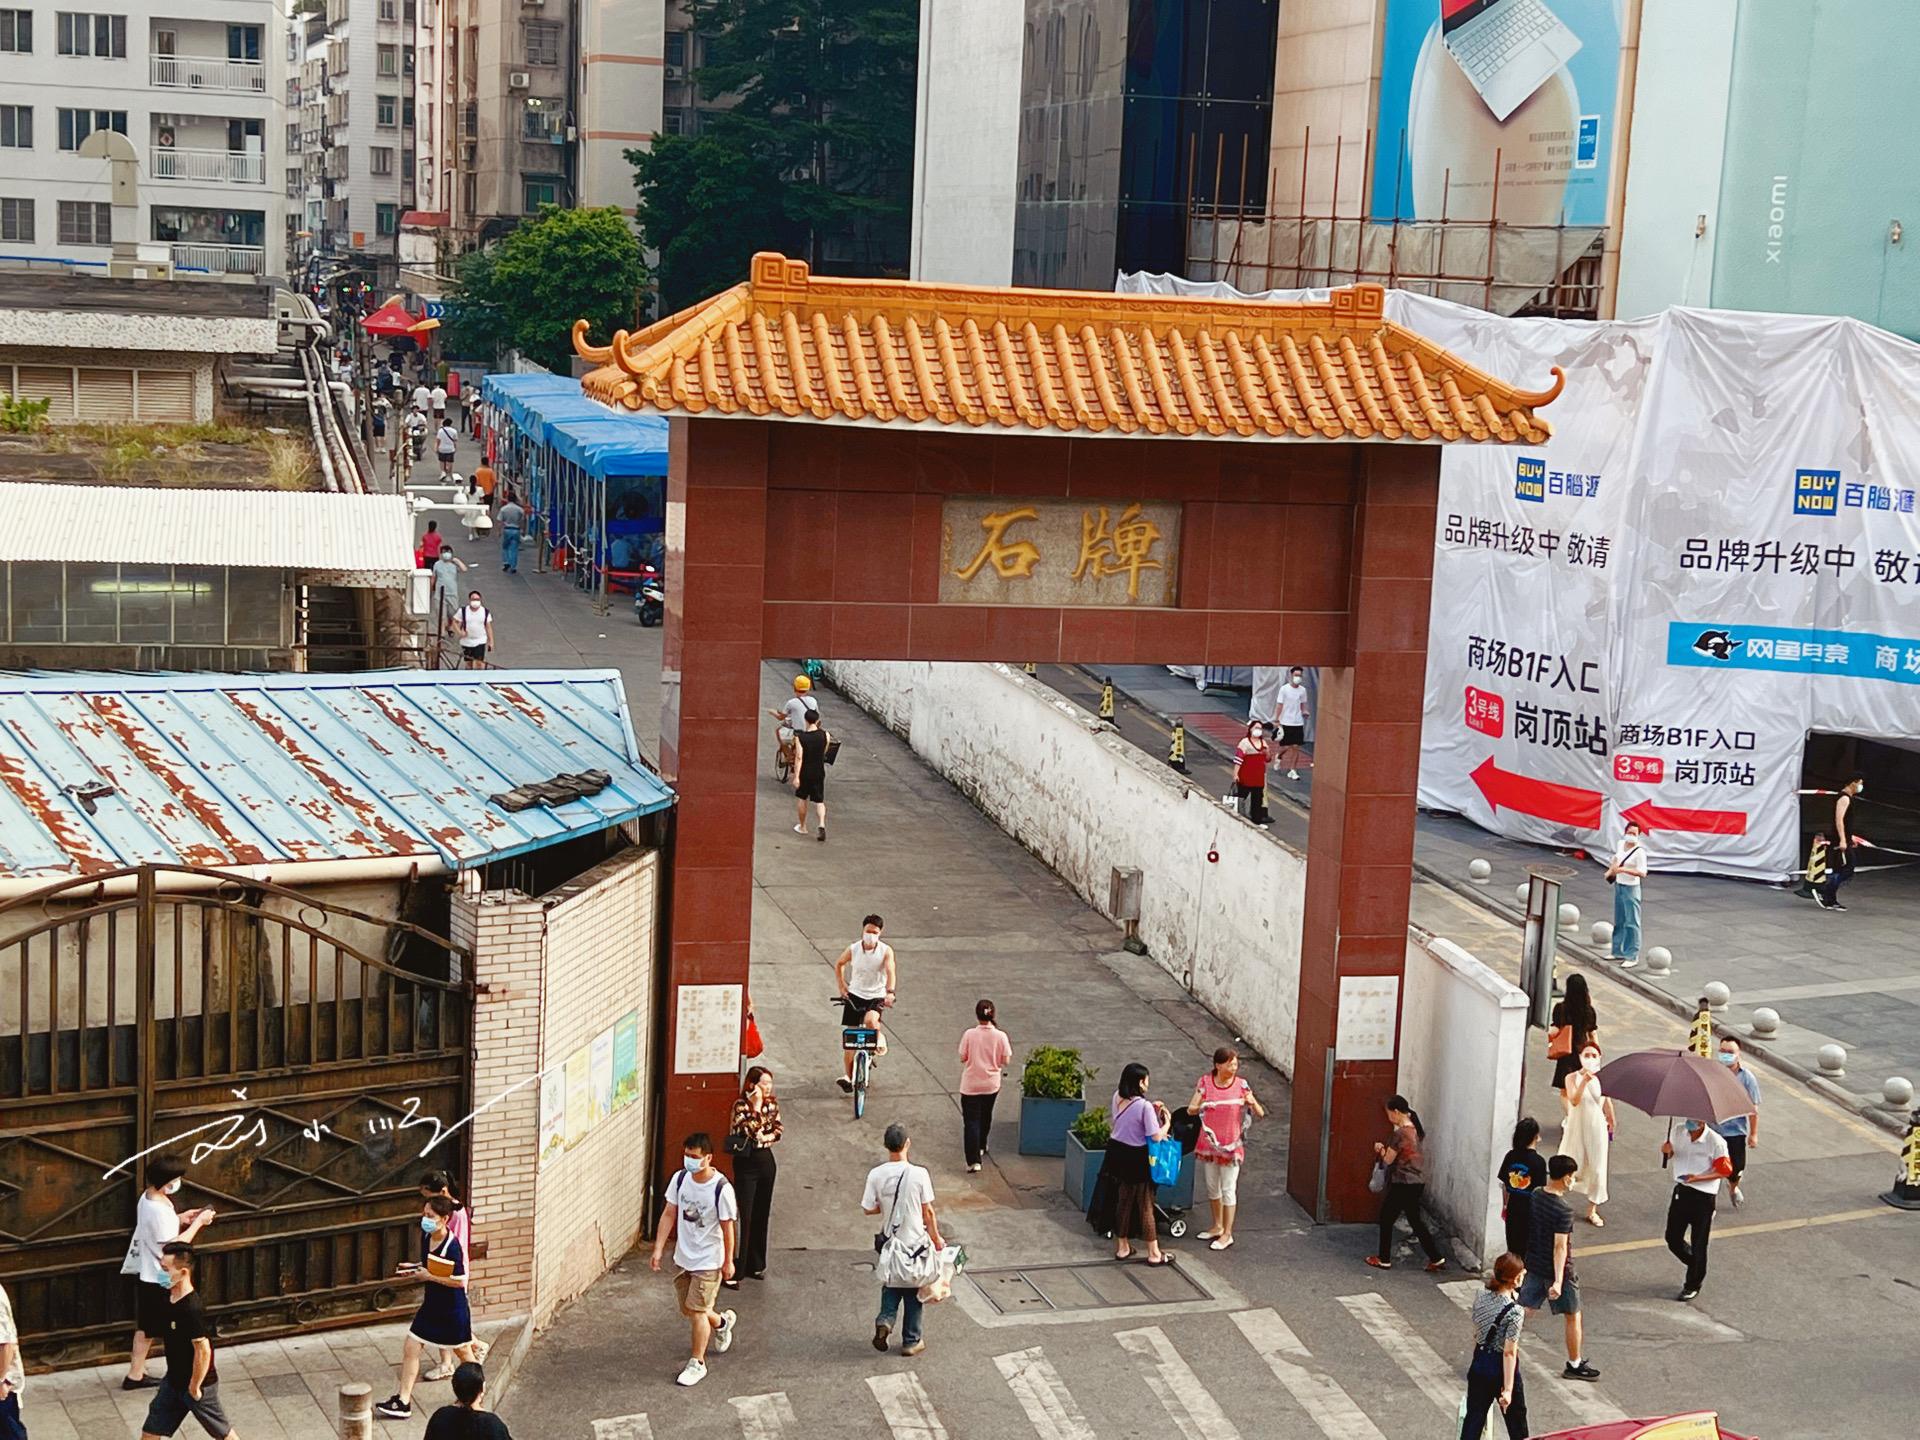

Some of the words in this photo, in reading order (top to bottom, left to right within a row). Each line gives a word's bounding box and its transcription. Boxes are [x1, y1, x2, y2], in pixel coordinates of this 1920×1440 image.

[1518, 463, 1543, 478] BUY
[1799, 476, 1836, 491] BUY
[1517, 481, 1543, 497] NOW
[1798, 495, 1834, 510] NOW
[954, 502, 1162, 599] 石牌
[1444, 513, 1560, 560] 品牌升级中
[1567, 532, 1612, 569] 敬请
[1680, 538, 1855, 577] 品牌升级中
[1874, 549, 1920, 585] 敬
[1468, 635, 1600, 694] 商场B1F入口
[1468, 690, 1500, 723] 3号线
[1515, 700, 1608, 757] 岗顶站
[1619, 723, 1755, 750] 商场B1F入口
[1618, 756, 1659, 775] 3号线
[1675, 759, 1756, 786] 岗顶站
